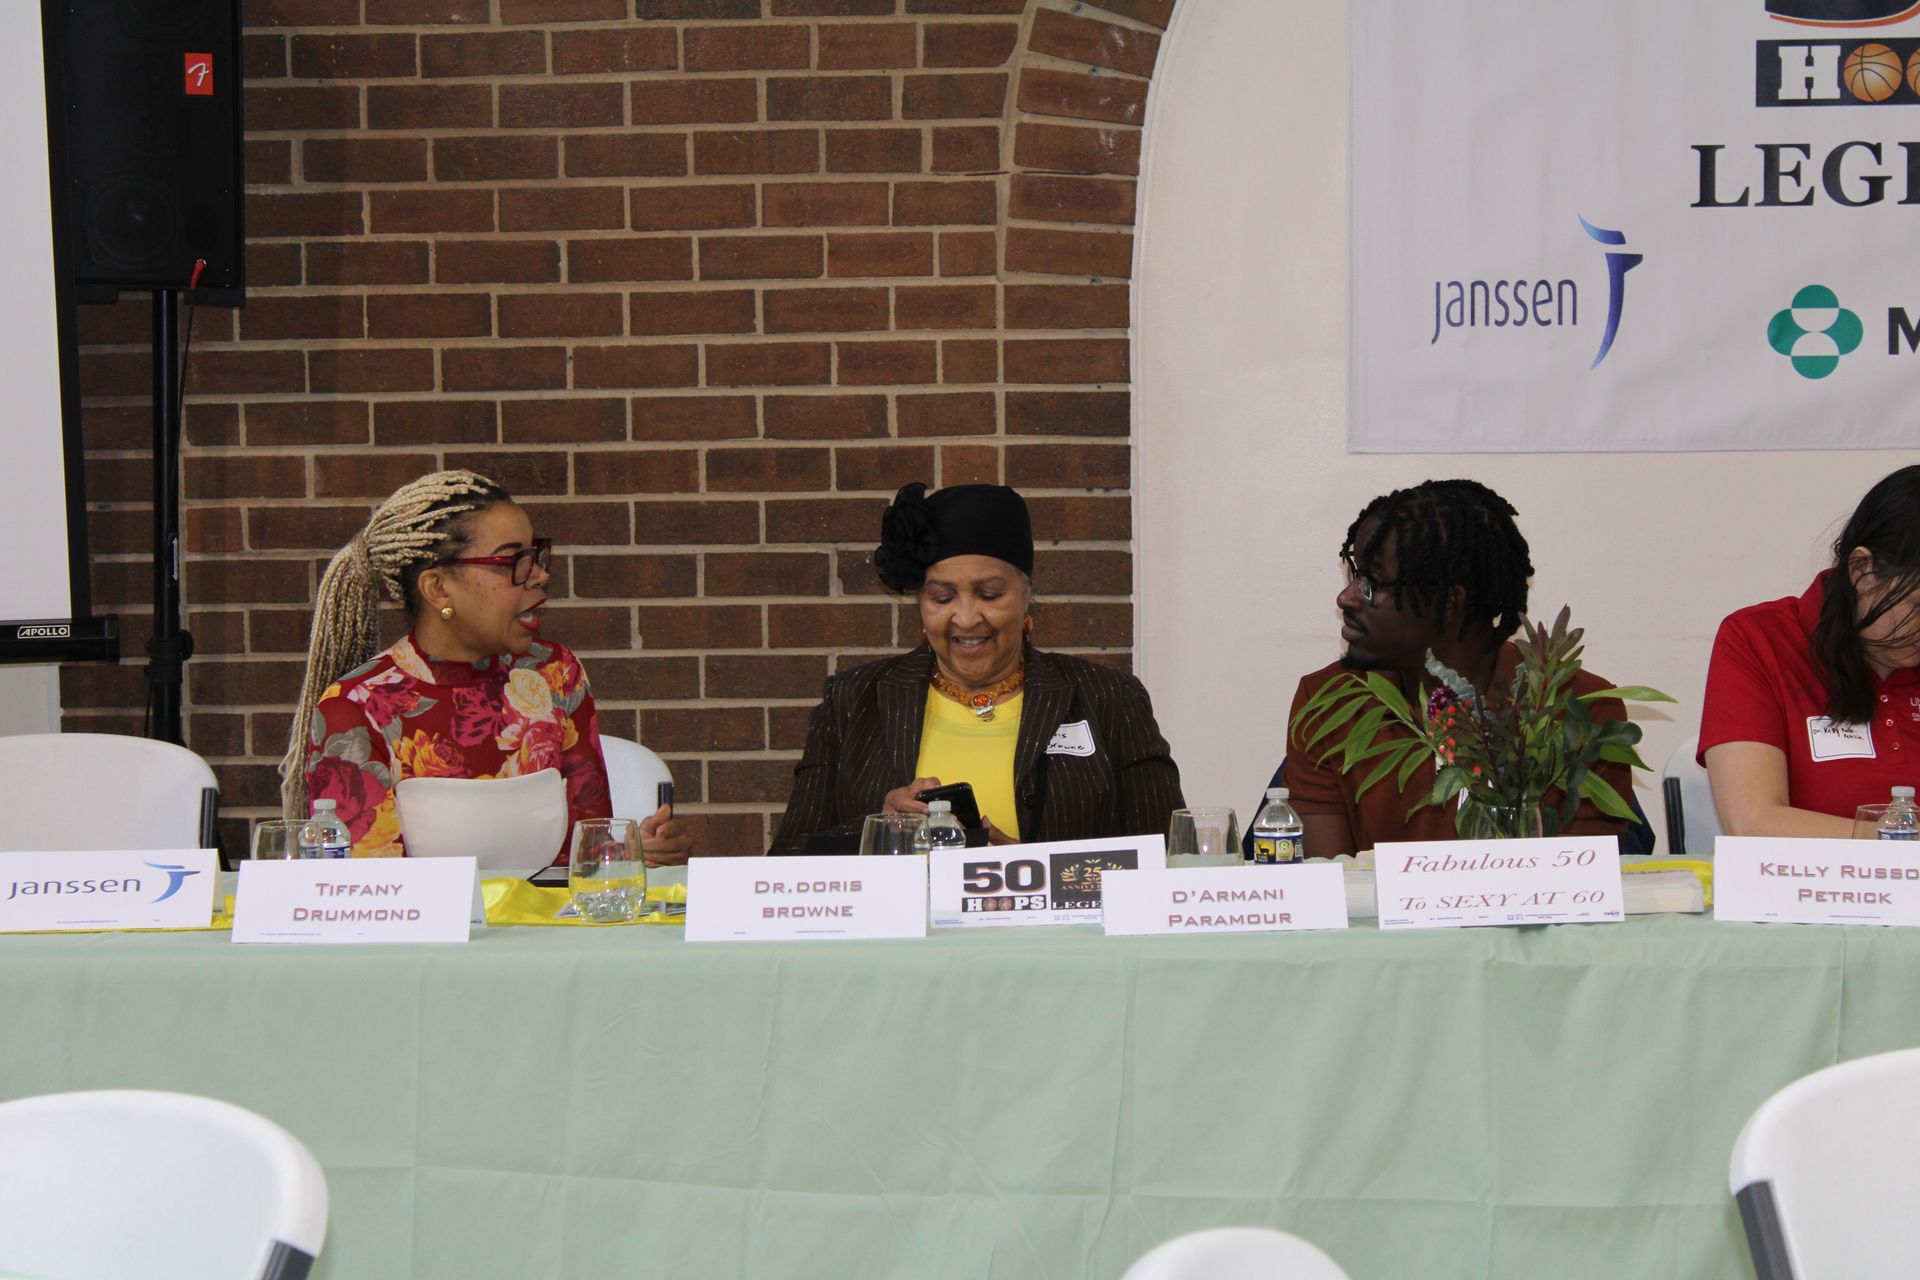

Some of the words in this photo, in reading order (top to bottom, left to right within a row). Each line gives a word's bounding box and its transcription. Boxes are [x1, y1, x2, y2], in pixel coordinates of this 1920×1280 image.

[20, 628, 68, 637] APOLLO
[1399, 853, 1540, 873] Fabulous
[1552, 849, 1597, 868] 50
[963, 859, 1047, 894] 50
[1760, 862, 1829, 878] KELLY
[1400, 897, 1427, 911] To
[1436, 893, 1518, 909] SEXY
[1520, 891, 1567, 905] AT
[1572, 890, 1605, 904] 60
[1798, 888, 1893, 905] PETRICK
[762, 906, 854, 919] BROWNE
[1168, 912, 1293, 927] PARAMOUR
